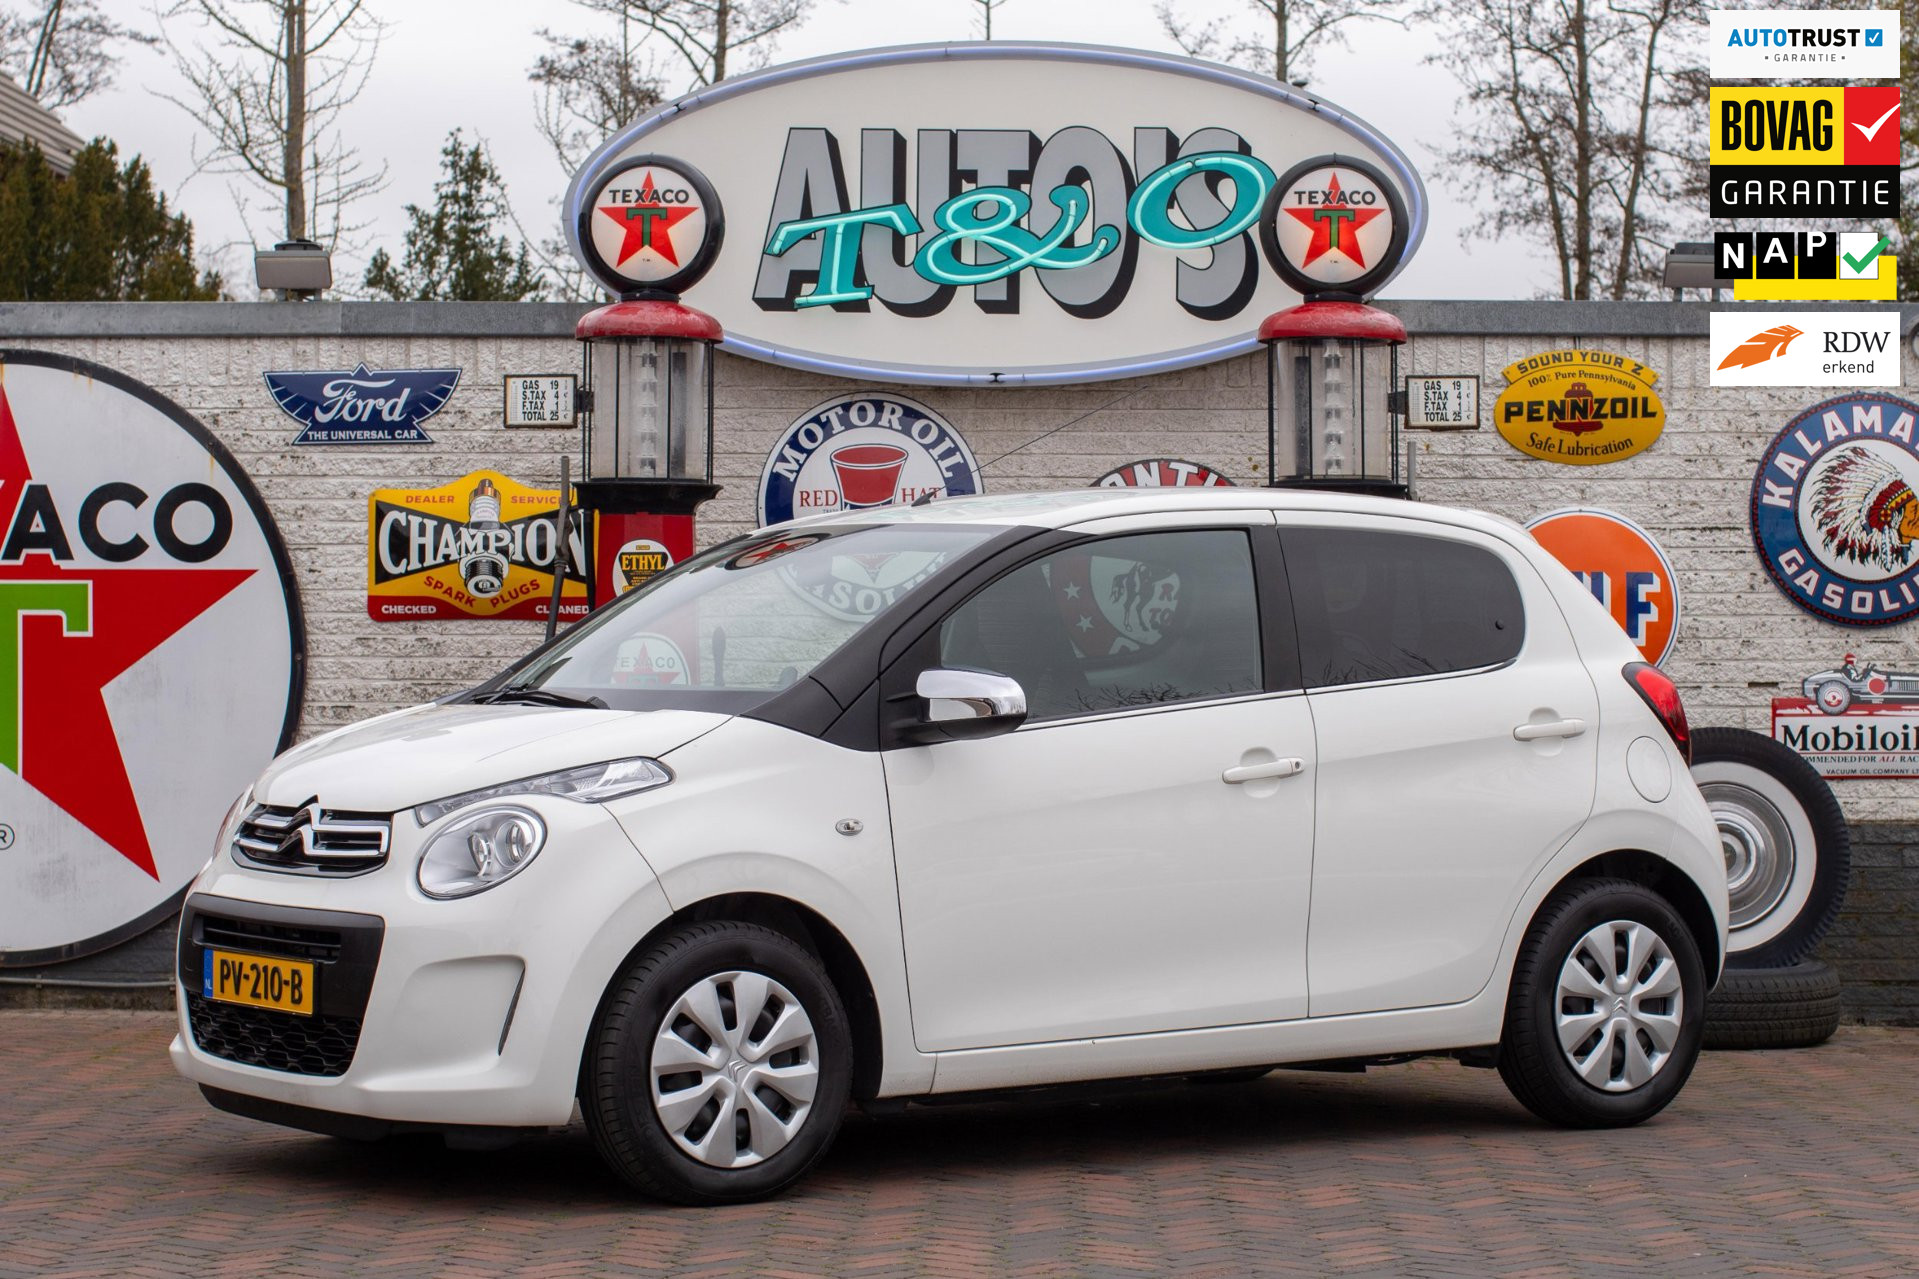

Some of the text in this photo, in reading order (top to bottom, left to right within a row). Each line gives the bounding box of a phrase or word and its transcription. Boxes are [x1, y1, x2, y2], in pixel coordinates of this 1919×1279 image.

[608, 188, 690, 204] TEXACO
[1293, 190, 1376, 206] TEXACO
[752, 125, 1262, 321] AUTO'S
[1517, 351, 1644, 376] SOUND YOUR Z
[522, 380, 540, 390] GAS
[550, 380, 559, 390] 19
[1424, 380, 1442, 390] GAS
[1452, 380, 1461, 390] 19
[1555, 370, 1577, 380] Pure
[1578, 369, 1637, 391] Pennsylvania
[314, 378, 411, 423] Ford
[522, 391, 546, 400] S.TAX
[554, 391, 559, 400] 4
[1424, 391, 1448, 400] S.TAX
[1456, 391, 1462, 400] 4
[522, 401, 545, 410] F.TAX
[555, 401, 559, 410] 1
[1424, 402, 1447, 411] F.TAX
[1458, 402, 1462, 411] 1
[1504, 397, 1657, 423] PENNZOIL
[522, 411, 547, 421] TOTAL
[550, 411, 559, 421] 25
[1424, 412, 1449, 422] TOTAL
[1452, 412, 1462, 422] 25
[307, 429, 418, 440] THE UNIVERSAL CAR
[772, 401, 966, 482] MOTOR OIL
[1526, 432, 1633, 456] Safe Lubrication
[1762, 405, 1919, 509] KALAMA
[405, 495, 455, 504] DEALER
[799, 489, 838, 507] RED
[0, 481, 233, 563] ACO
[378, 508, 587, 576] CHAMPION
[621, 554, 665, 571] ETHYL
[1778, 548, 1919, 614] GASOLI
[424, 575, 541, 608] SPARK PLUGS
[381, 604, 437, 614] CHECKED
[535, 604, 590, 614] CLANED
[205, 978, 212, 990] NL
[219, 958, 303, 1005] PV-210-B
